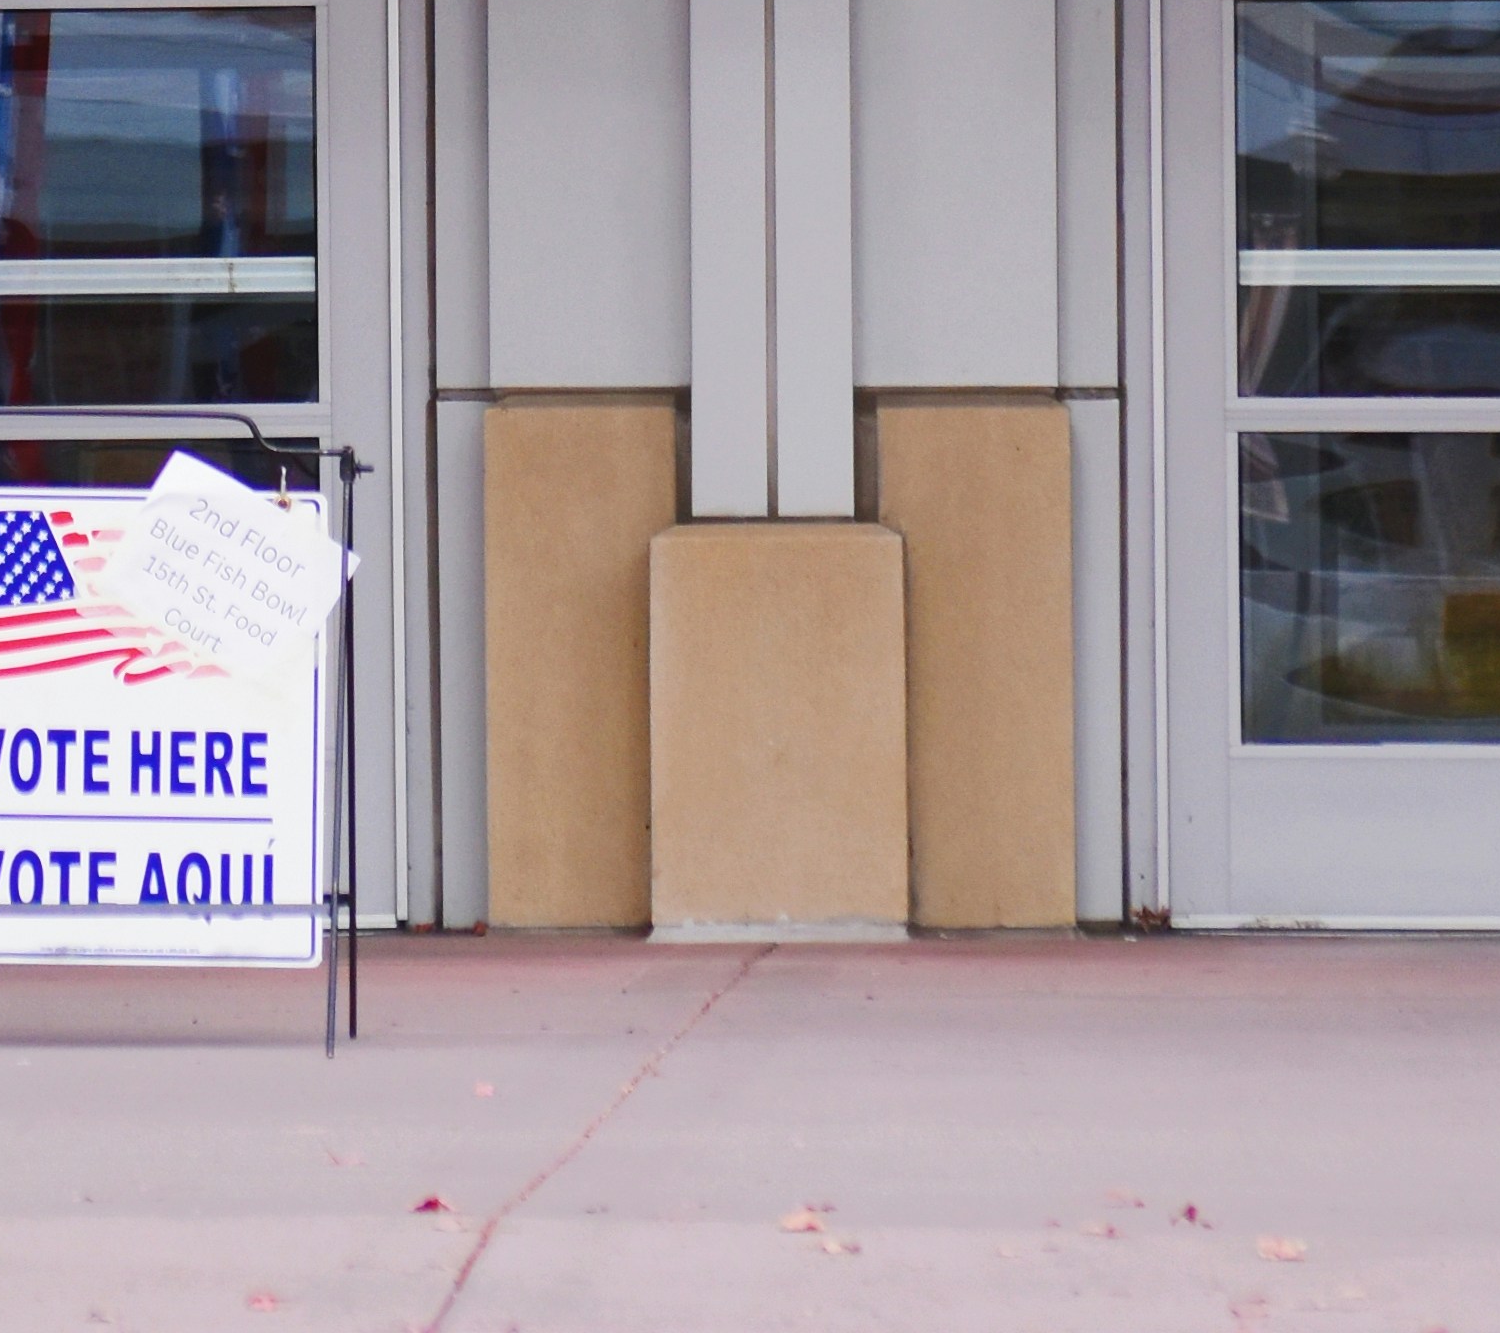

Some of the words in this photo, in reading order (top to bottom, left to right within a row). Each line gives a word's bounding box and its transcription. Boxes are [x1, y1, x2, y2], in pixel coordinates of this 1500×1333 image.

[150, 518, 200, 560] Blue
[203, 550, 247, 589] Fish
[251, 581, 307, 626] Bowl
[189, 498, 240, 538] 2nd
[240, 529, 306, 578] Floor
[143, 556, 189, 594] 15th
[192, 586, 216, 614] St.
[224, 605, 278, 646] Food
[164, 608, 222, 654] Court
[130, 730, 269, 798] HERE
[139, 838, 275, 925] AQUÍ
